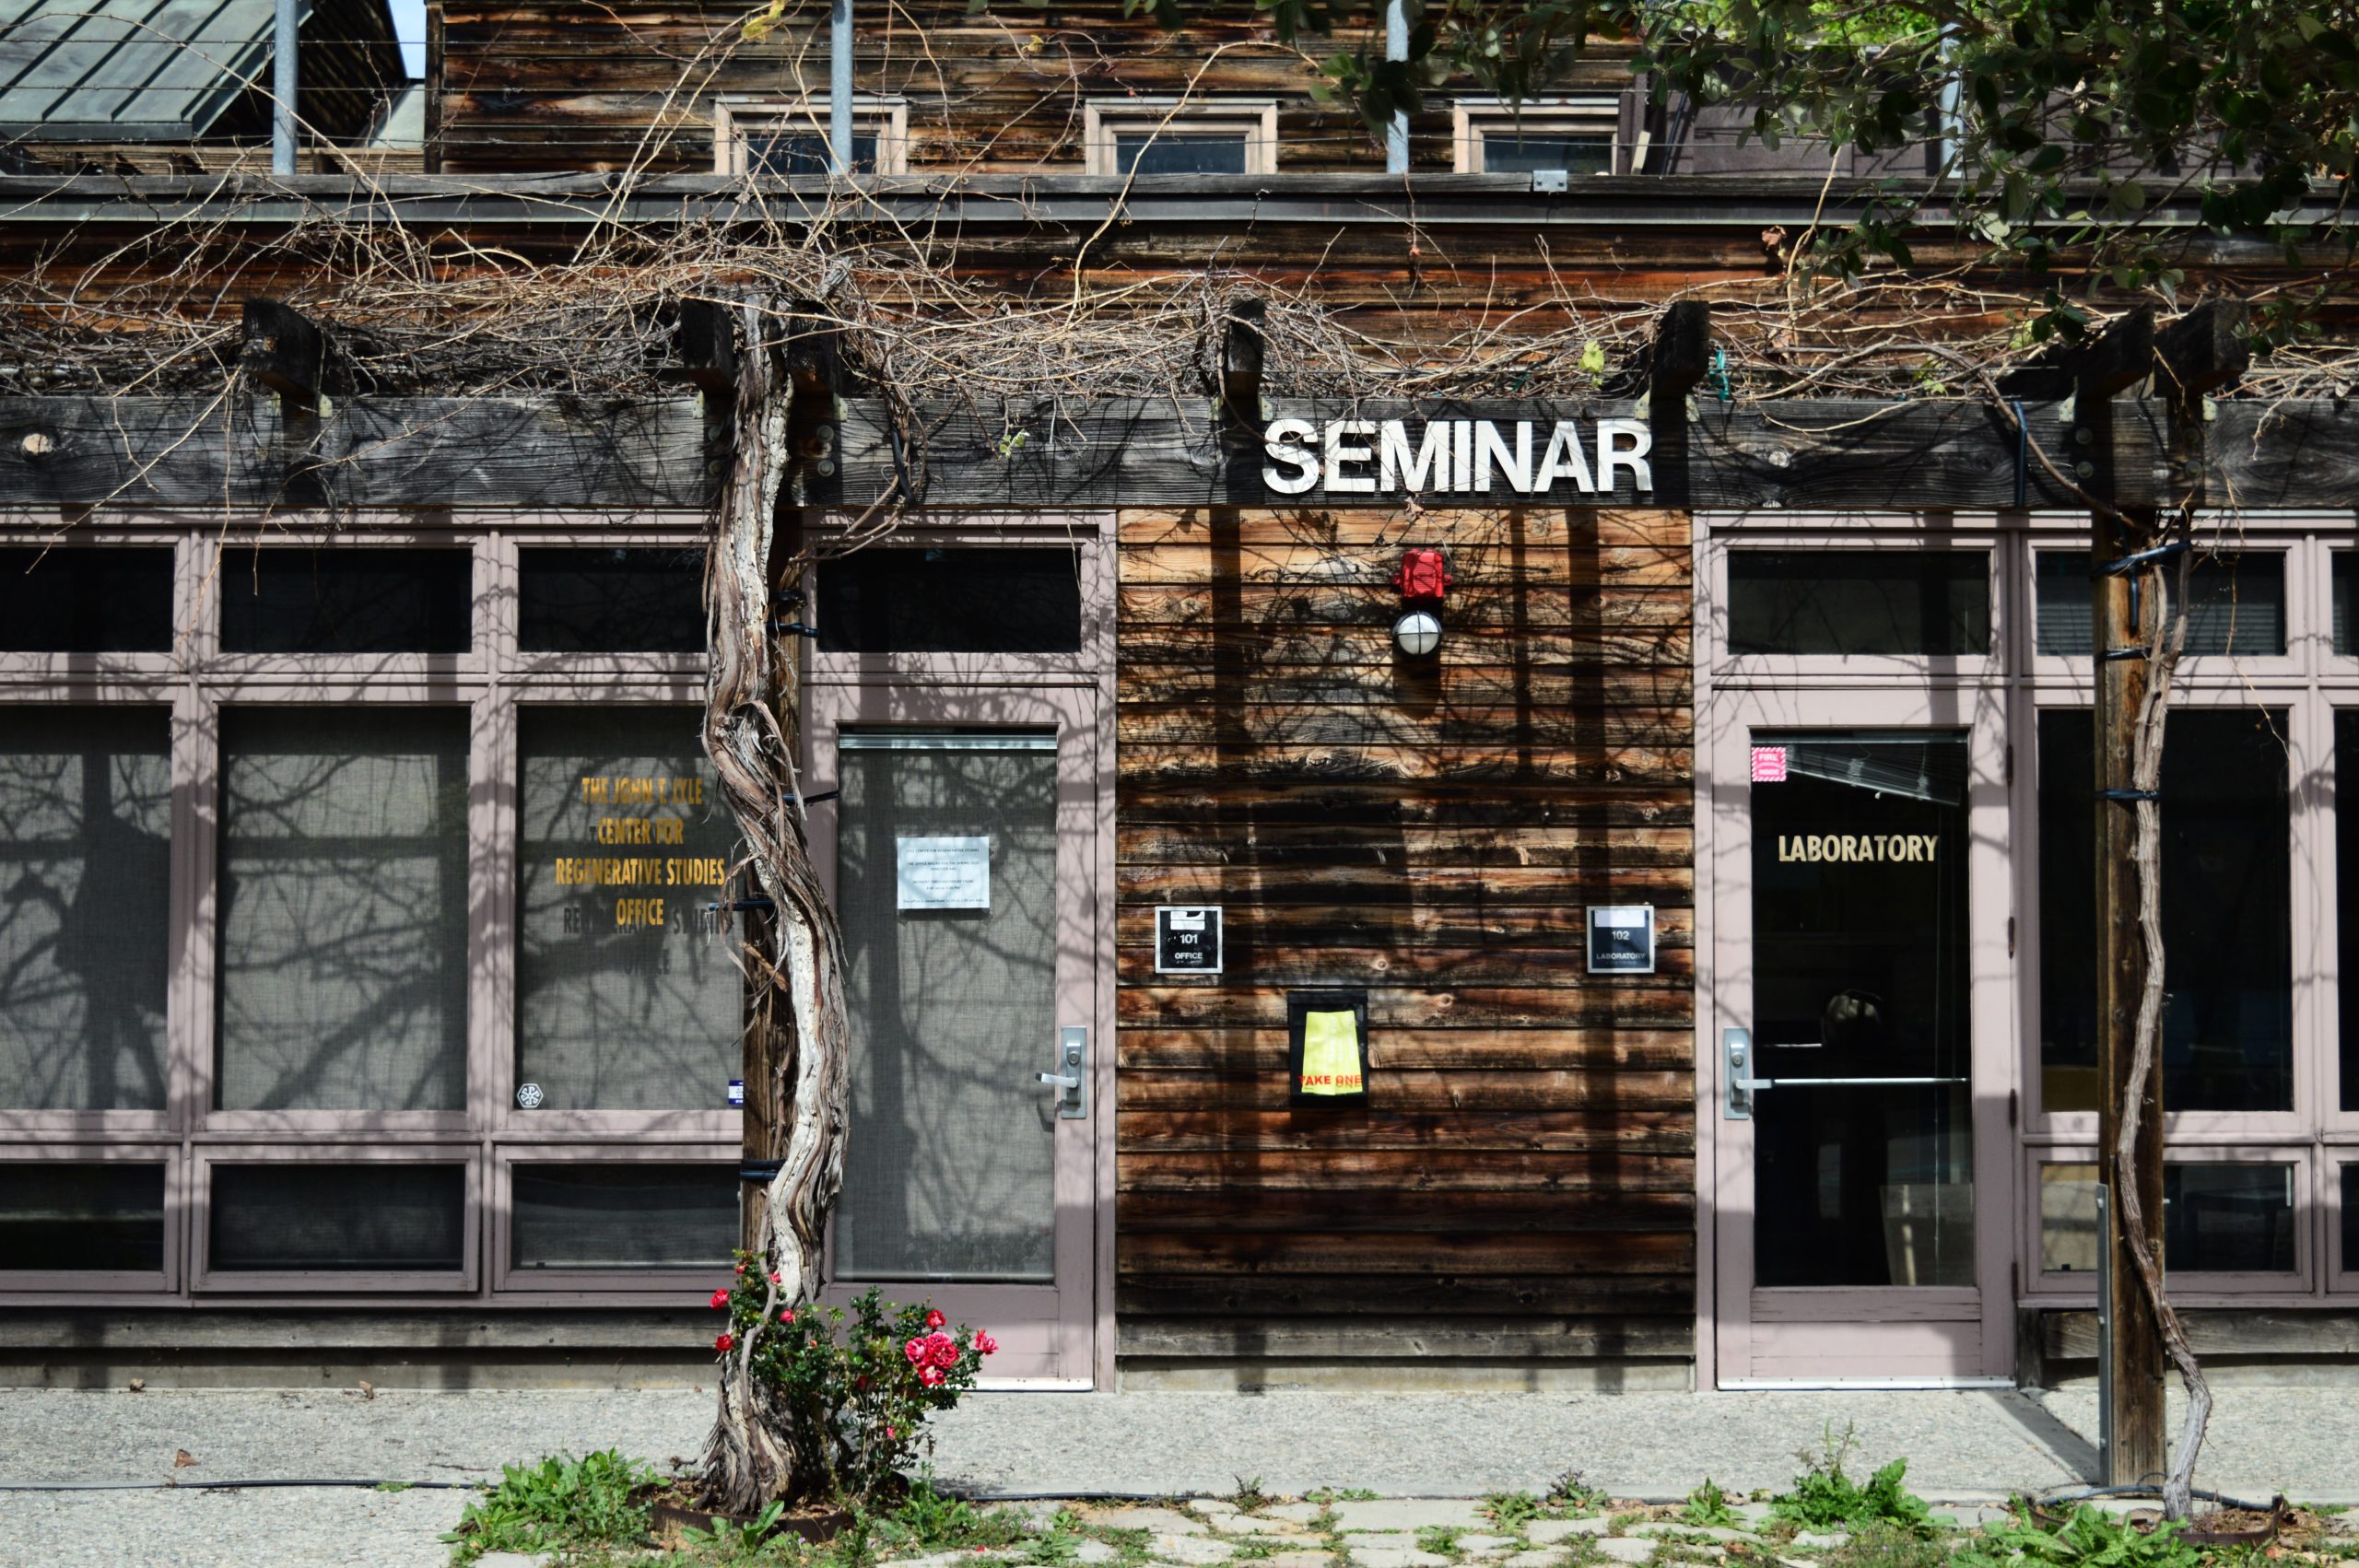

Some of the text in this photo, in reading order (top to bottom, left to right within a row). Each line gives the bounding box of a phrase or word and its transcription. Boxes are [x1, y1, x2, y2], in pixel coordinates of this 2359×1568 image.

[1262, 419, 1653, 494] SEMINAR
[1758, 753, 1778, 762] FIRE
[581, 778, 703, 804] THE JOHN T. LYLE
[597, 817, 684, 845] CENTER FOR
[1778, 834, 1939, 862] LABORATORY
[555, 858, 725, 885] REGENERATIVE STUDIES
[616, 898, 664, 926] OFFICE
[1180, 933, 1198, 944] 101
[1611, 930, 1630, 941] 102
[1174, 952, 1203, 960] OFFICE
[1595, 952, 1646, 960] LABORATORY
[1298, 1075, 1363, 1085] TAKE ONE
